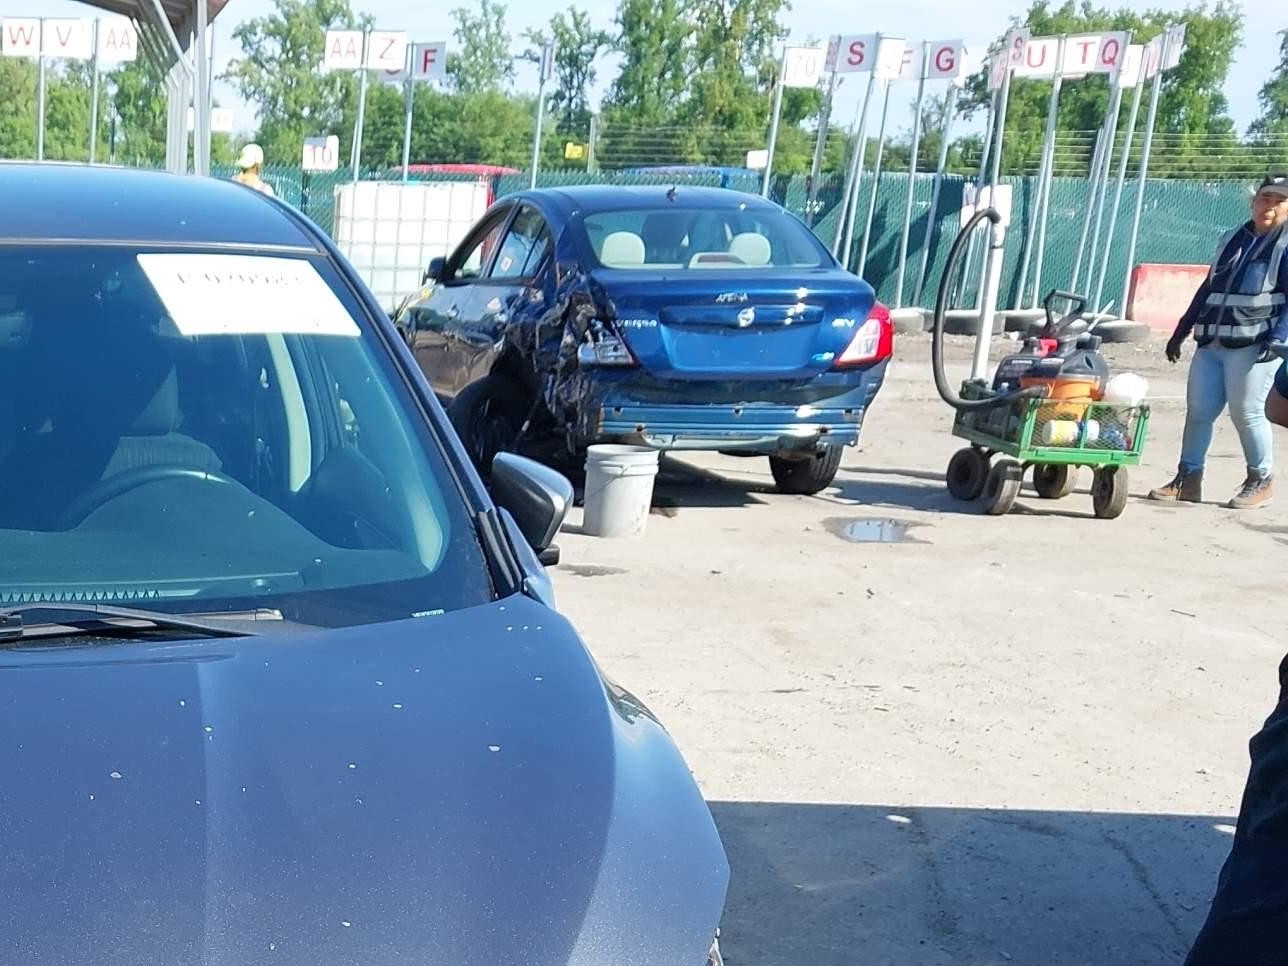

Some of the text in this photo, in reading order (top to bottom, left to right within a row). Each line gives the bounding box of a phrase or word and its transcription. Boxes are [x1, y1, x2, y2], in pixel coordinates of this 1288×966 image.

[8, 24, 34, 46] W
[55, 25, 72, 47] V
[105, 27, 132, 49] AA
[330, 37, 357, 59] AA
[378, 37, 397, 60] Z
[847, 41, 866, 66] S
[935, 46, 955, 72] G
[1026, 44, 1047, 68] U
[1075, 40, 1096, 65] T
[1101, 38, 1120, 66] Q
[422, 48, 438, 74] F
